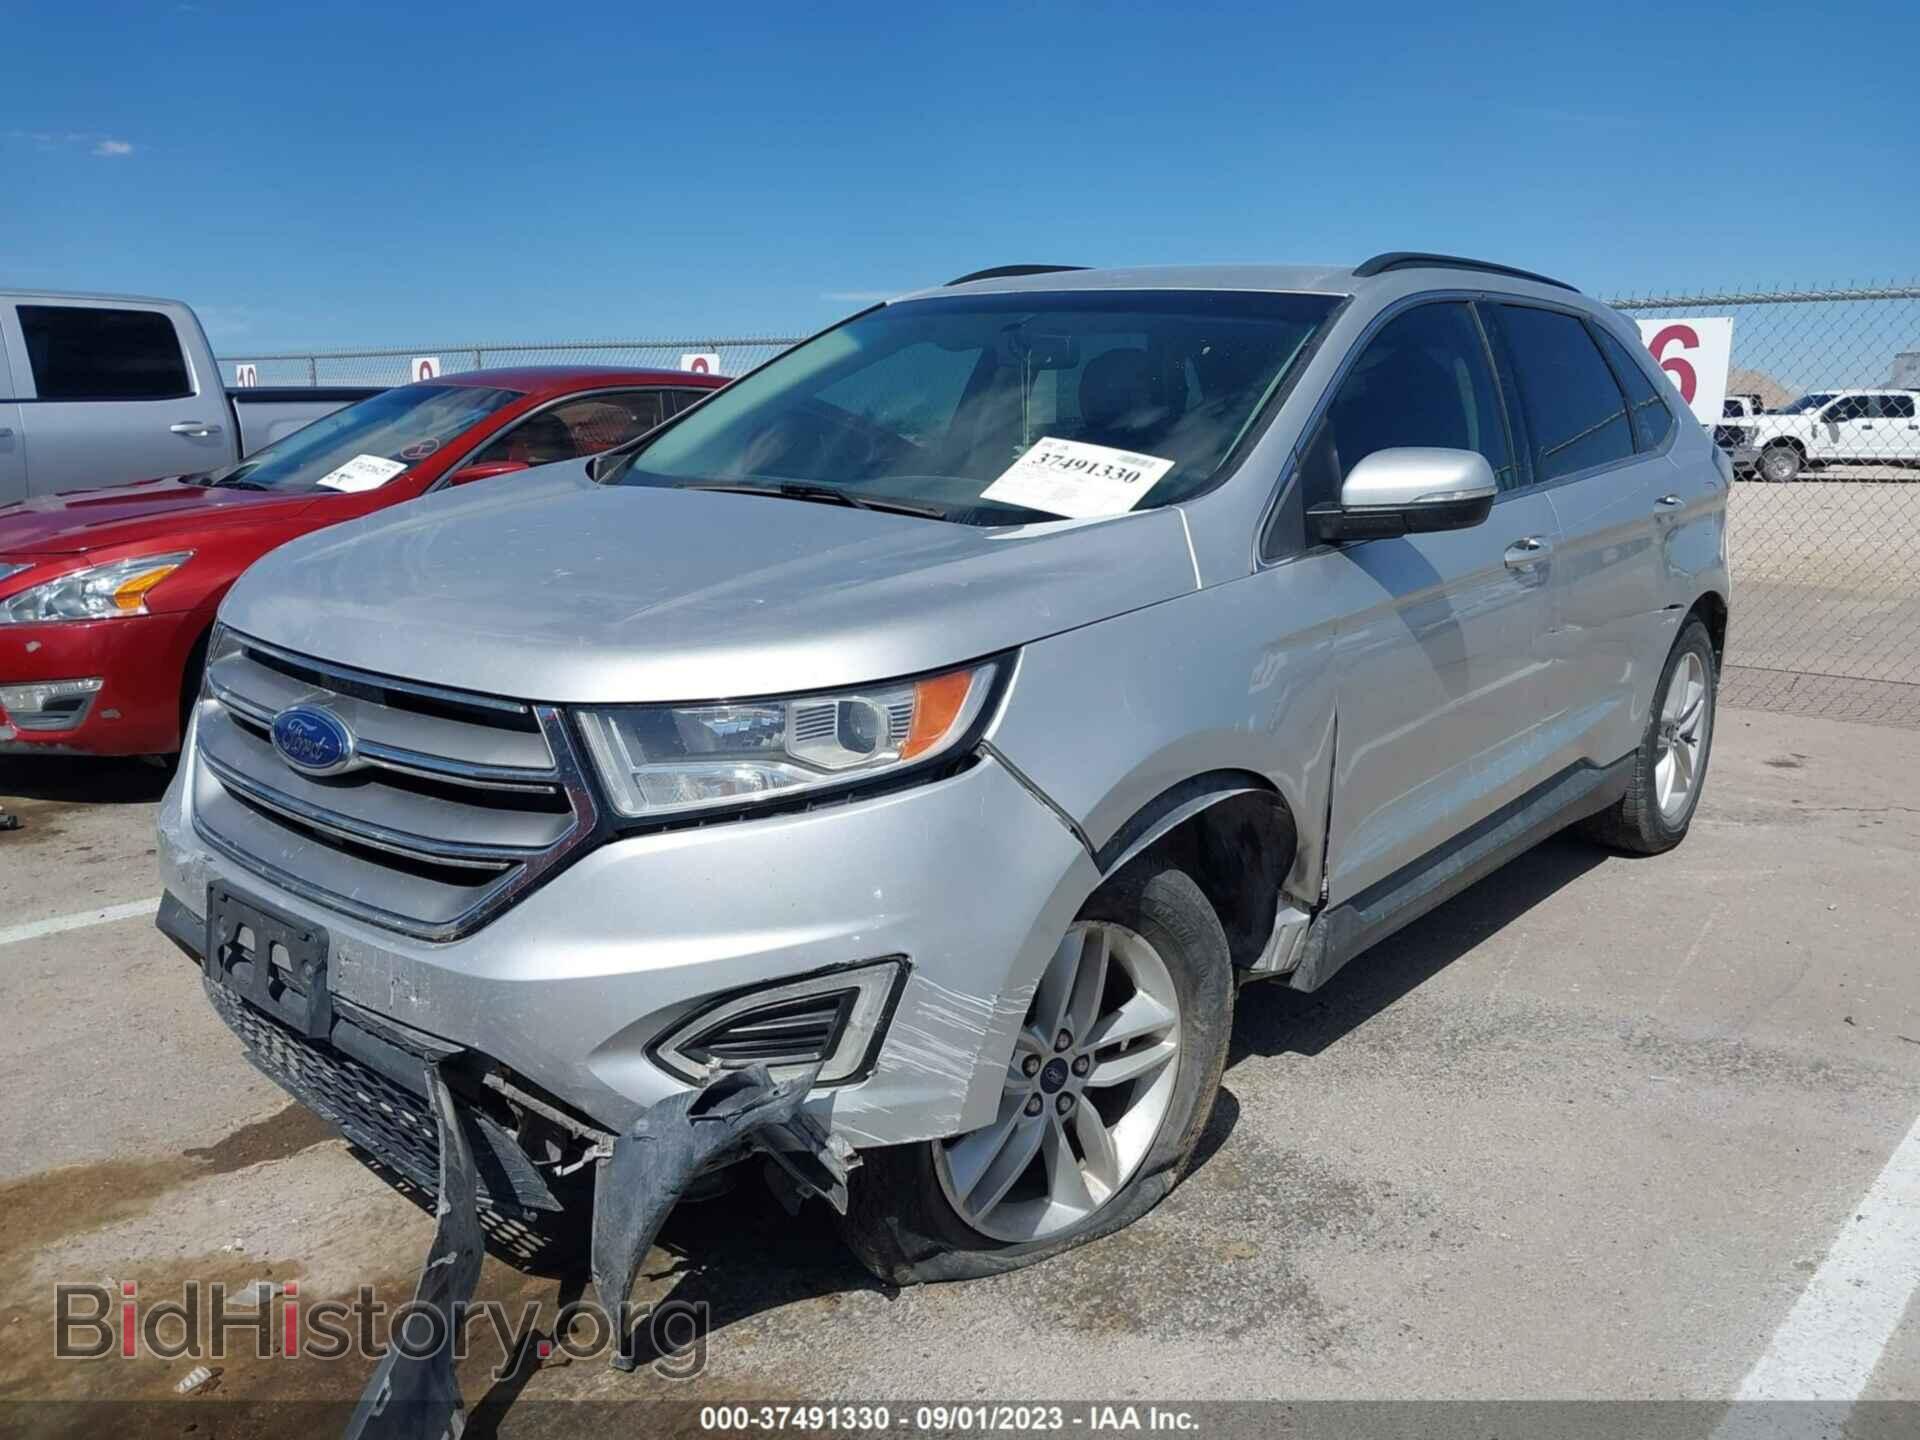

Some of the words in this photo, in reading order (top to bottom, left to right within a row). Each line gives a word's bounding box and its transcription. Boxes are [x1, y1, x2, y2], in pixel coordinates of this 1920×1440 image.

[1649, 325, 1700, 405] 6
[1032, 452, 1141, 484] 37491330
[281, 718, 330, 761] Ford
